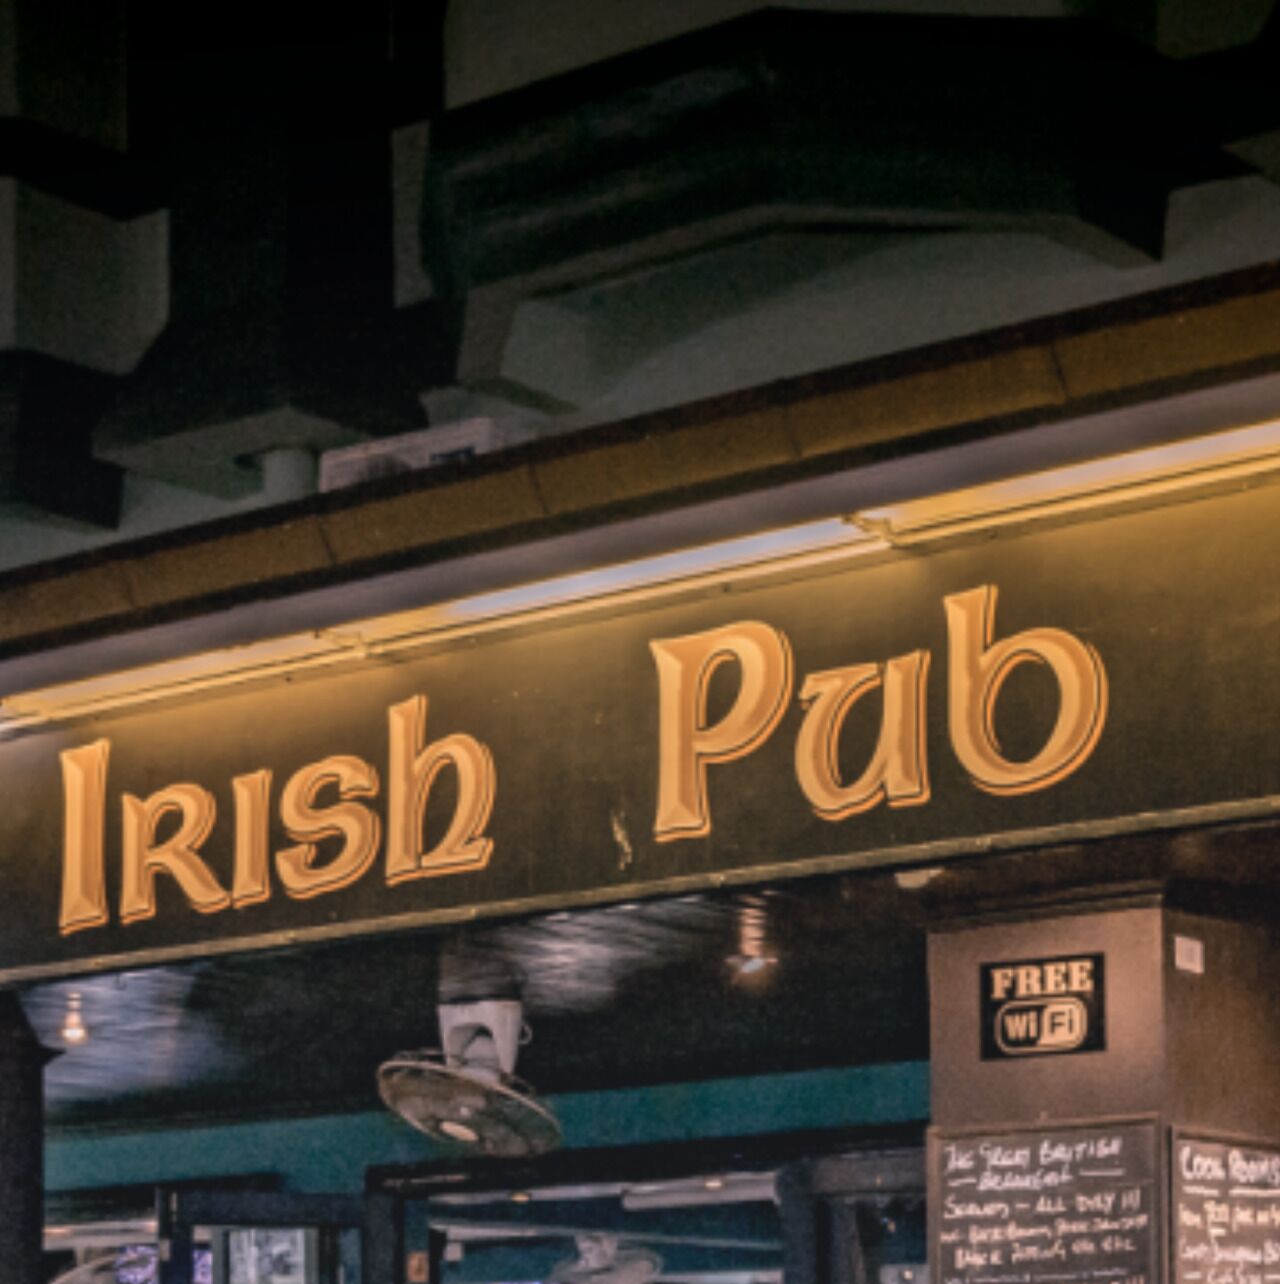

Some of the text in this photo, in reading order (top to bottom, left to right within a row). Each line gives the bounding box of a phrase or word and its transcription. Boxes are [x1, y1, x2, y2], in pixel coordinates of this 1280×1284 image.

[57, 583, 1110, 938] Irish Pub
[990, 959, 1095, 999] FREE
